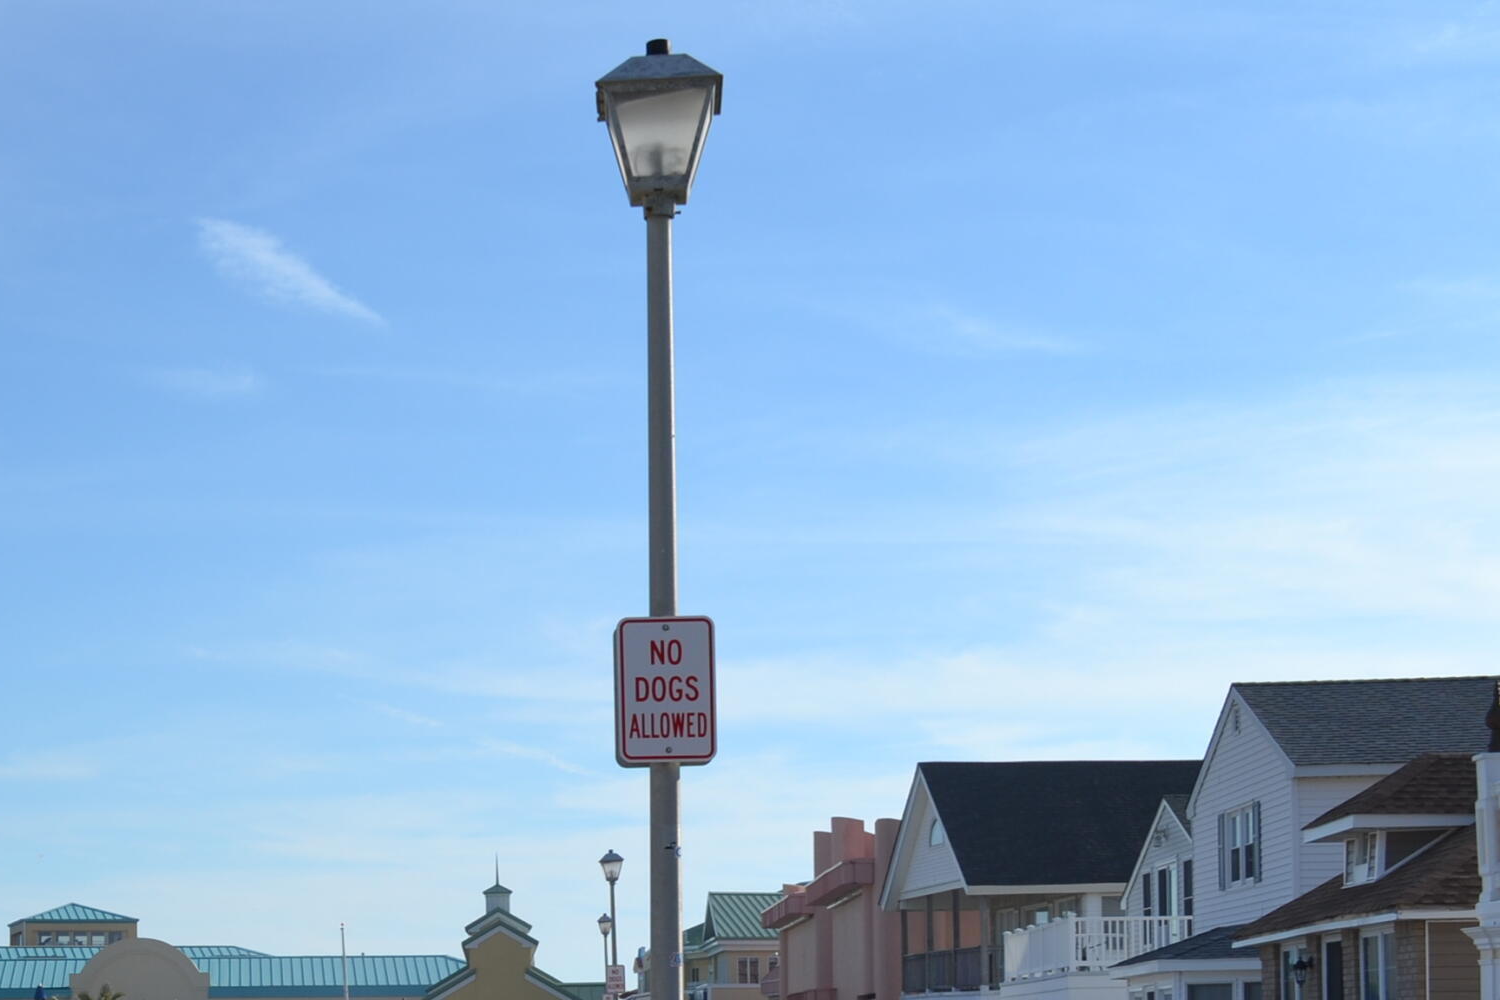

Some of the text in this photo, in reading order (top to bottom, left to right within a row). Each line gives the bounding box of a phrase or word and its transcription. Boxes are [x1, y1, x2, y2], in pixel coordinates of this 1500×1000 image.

[650, 639, 682, 665] NO
[635, 676, 699, 702] DOGS
[629, 712, 707, 738] ALLOWED
